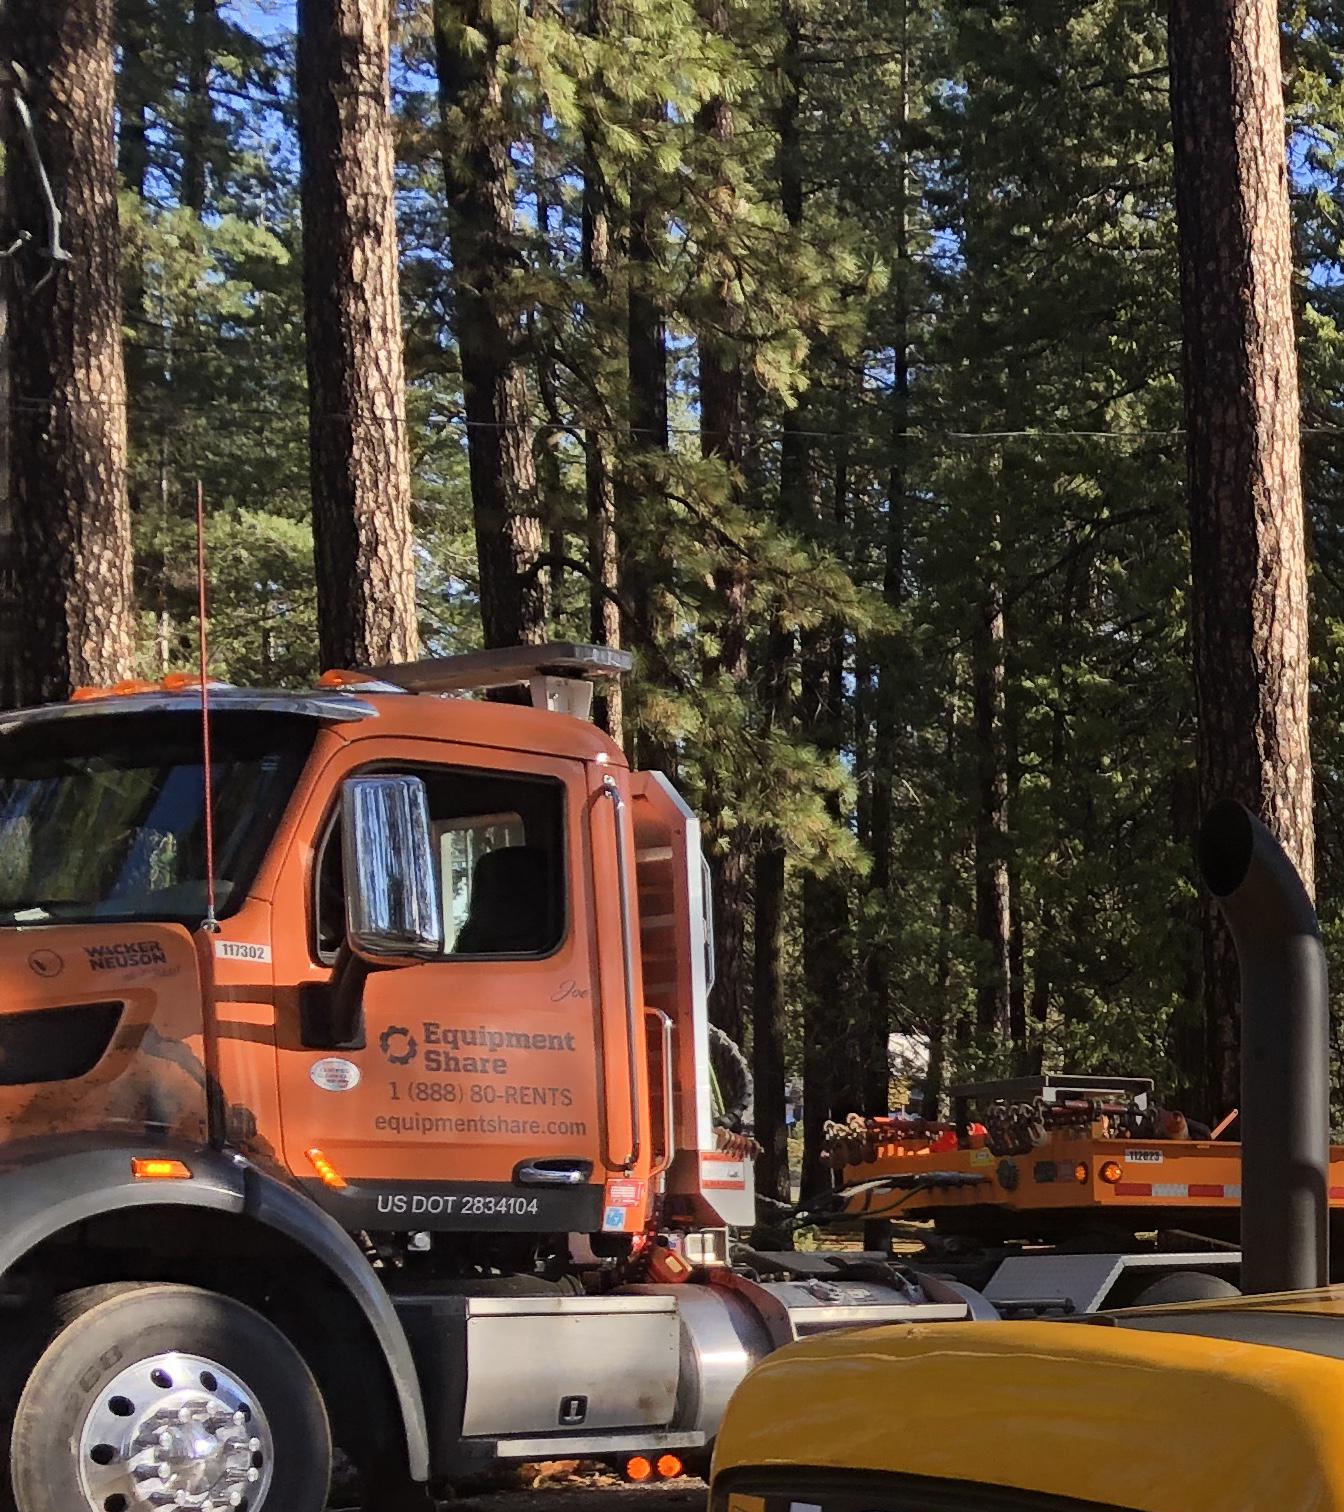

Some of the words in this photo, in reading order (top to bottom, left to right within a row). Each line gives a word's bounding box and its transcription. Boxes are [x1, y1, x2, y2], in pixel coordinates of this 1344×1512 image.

[83, 941, 161, 957] WACKER
[222, 943, 265, 960] 117302
[89, 952, 166, 970] NEUSON
[423, 1022, 575, 1052] Equipment
[424, 1049, 507, 1074] Share
[389, 1082, 400, 1101] 1
[408, 1081, 463, 1103] (888)
[470, 1084, 573, 1107] 80-RENTS
[375, 1112, 587, 1137] equipmentshare.com
[377, 1195, 407, 1214] US
[412, 1196, 457, 1214] DOT
[460, 1197, 538, 1215] 2834104
